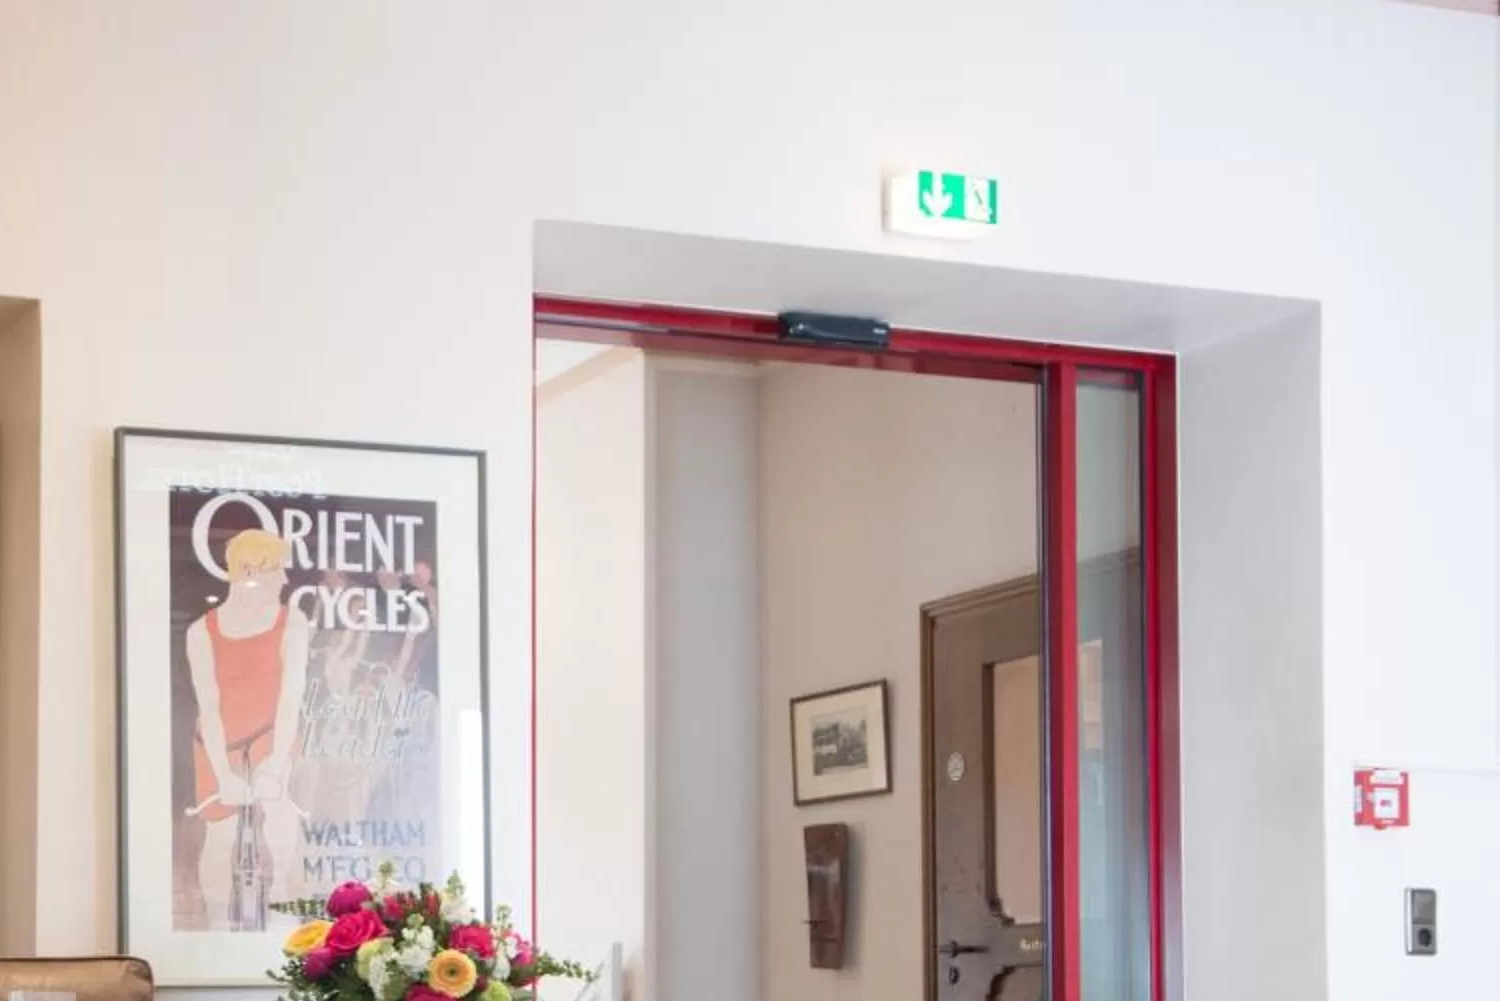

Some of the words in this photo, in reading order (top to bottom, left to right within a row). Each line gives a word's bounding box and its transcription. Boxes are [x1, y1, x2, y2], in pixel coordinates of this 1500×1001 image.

[192, 492, 425, 583] ORIENT
[290, 585, 430, 634] CYCLES
[299, 818, 426, 847] WALTHAM
